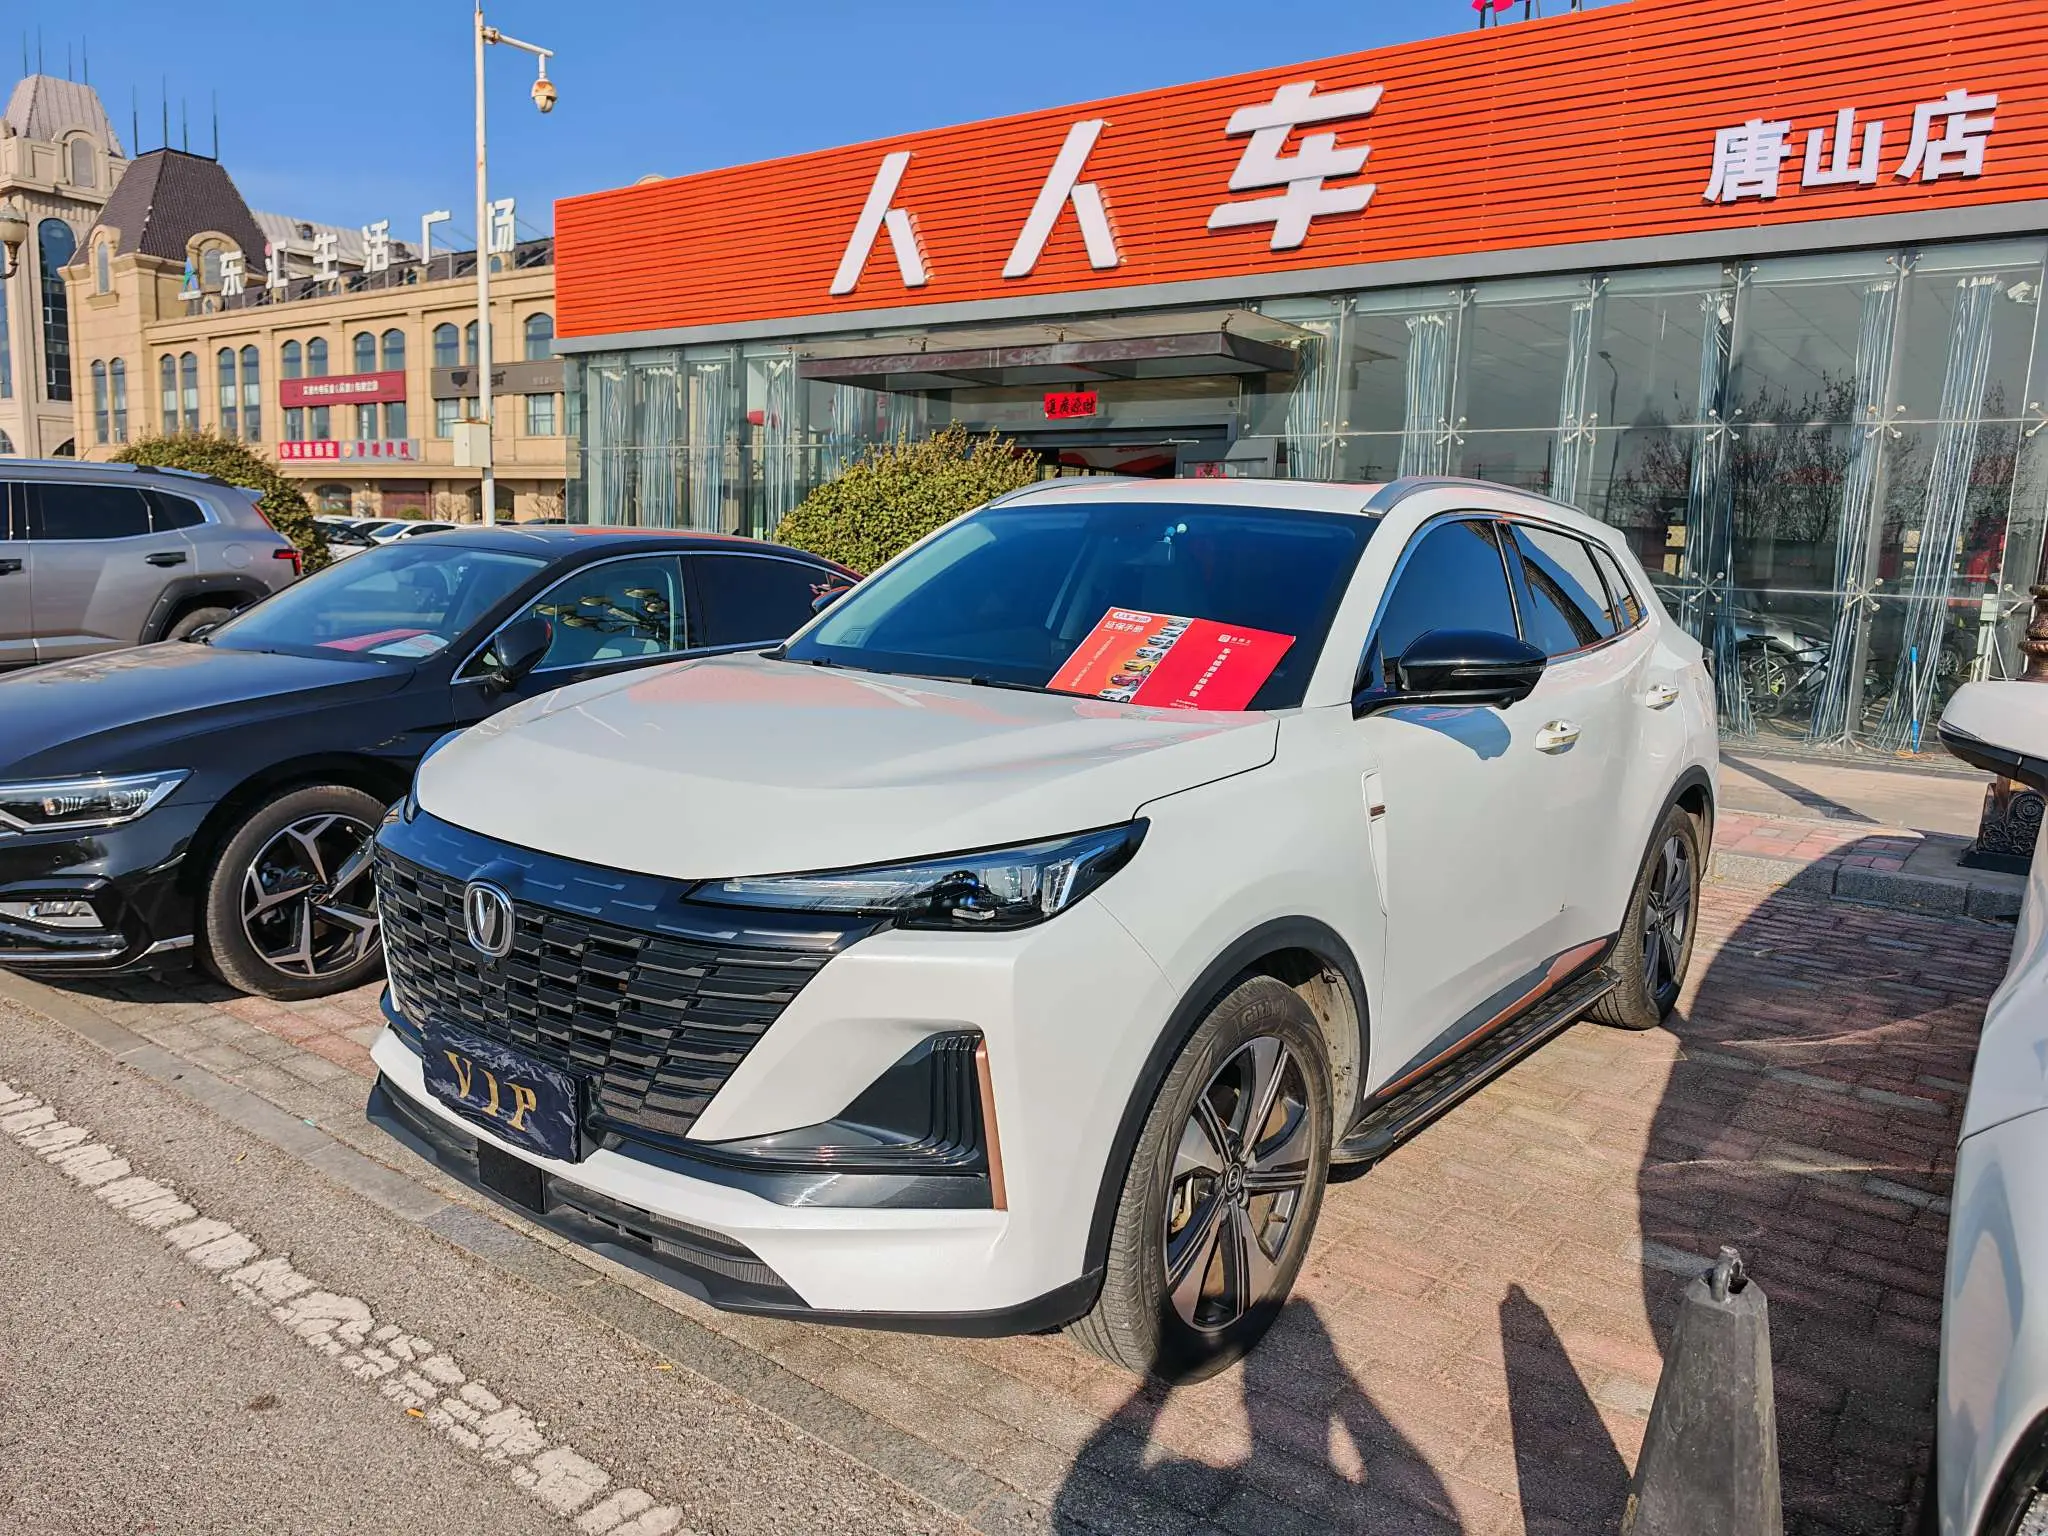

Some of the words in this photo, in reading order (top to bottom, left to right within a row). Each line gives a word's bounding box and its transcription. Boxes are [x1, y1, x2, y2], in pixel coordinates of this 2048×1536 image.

[829, 80, 1384, 296] 人人车
[1703, 88, 1998, 202] 唐山店
[443, 1050, 537, 1132] VIP
